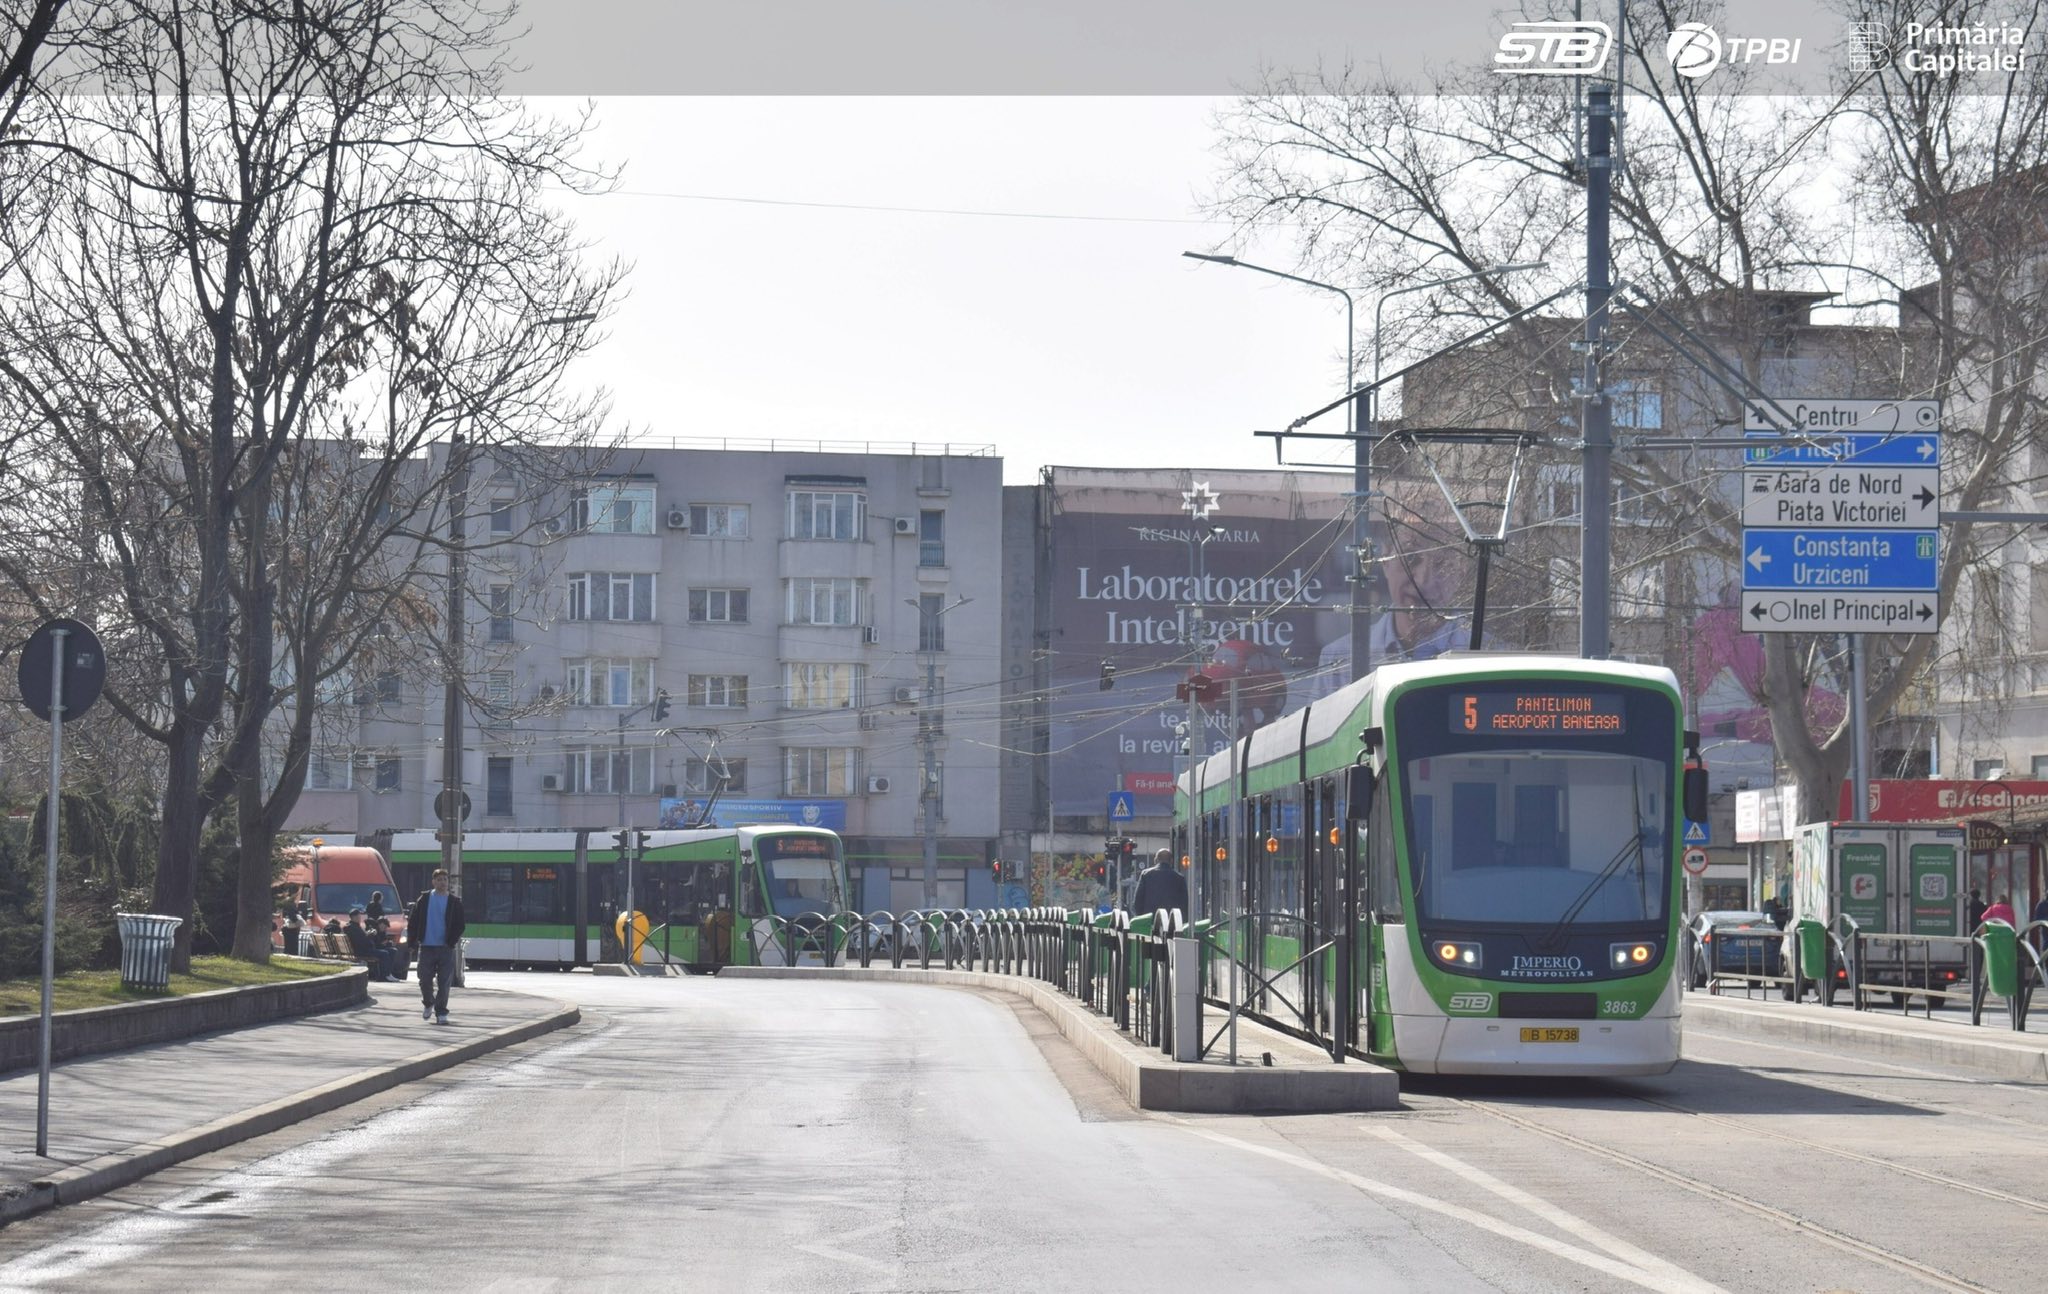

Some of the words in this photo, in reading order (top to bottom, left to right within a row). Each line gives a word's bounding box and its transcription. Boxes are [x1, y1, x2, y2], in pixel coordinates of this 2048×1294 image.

[1796, 404, 1858, 427] Centru
[1778, 473, 1820, 494] Gara
[1829, 474, 1850, 494] de
[1859, 473, 1902, 494] Nord
[1832, 501, 1906, 522] Victoriei
[1140, 527, 1201, 542] REGINA
[1077, 566, 1323, 602] Laboratoarele
[1793, 563, 1869, 585] Urziceni
[1793, 599, 1826, 620] Inel
[1833, 599, 1914, 626] Principal
[1464, 697, 1478, 730] 5
[1516, 697, 1592, 712] PANTELIMON
[1493, 714, 1557, 729] AEROPORT
[1562, 715, 1620, 729] BANEASA
[1119, 734, 1136, 753] la
[1512, 956, 1582, 971] IMPERIO
[1603, 1000, 1637, 1014] 3863
[1531, 1030, 1540, 1041] B
[1545, 1030, 1577, 1041] 15738
